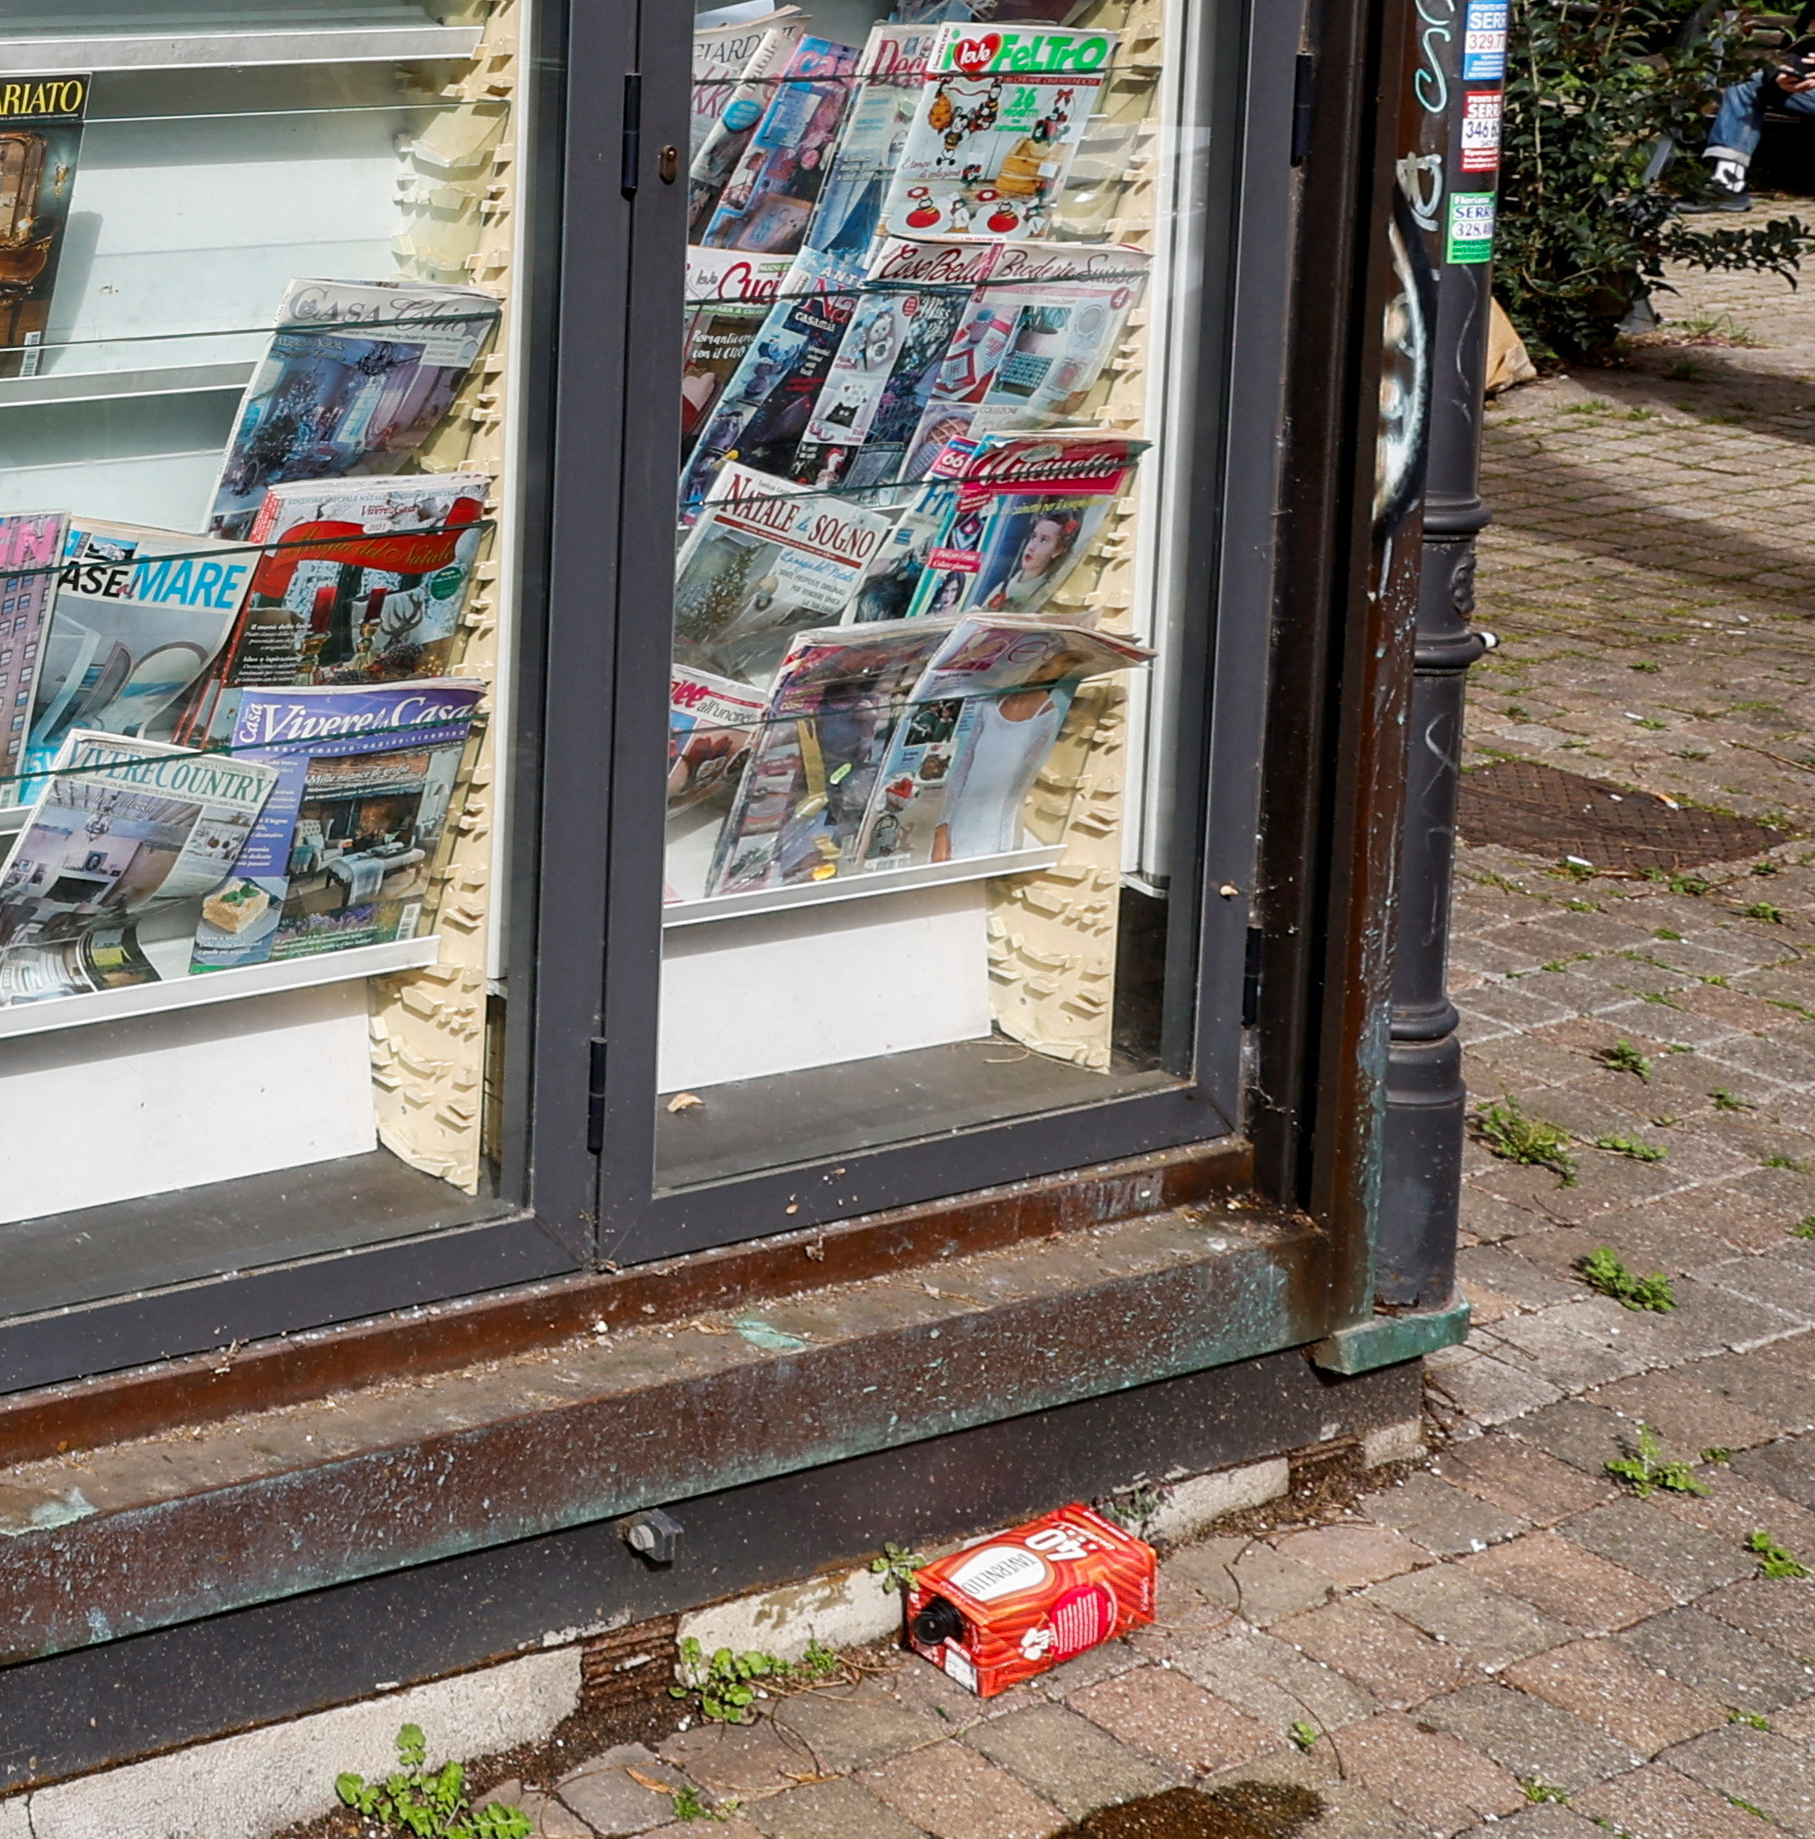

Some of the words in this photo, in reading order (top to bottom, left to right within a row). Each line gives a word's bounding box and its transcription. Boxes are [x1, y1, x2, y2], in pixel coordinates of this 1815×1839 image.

[959, 42, 992, 65] love
[1010, 87, 1037, 109] 26
[942, 452, 964, 469] 66
[720, 472, 802, 533] NATALE
[806, 512, 878, 559] SOGNO
[132, 554, 249, 610] MARE
[239, 703, 264, 744] Casa
[263, 704, 372, 744] Vivere
[392, 697, 474, 729] Casa
[1024, 1528, 1089, 1562] 40
[960, 1552, 1038, 1596] TAVERNELLO
